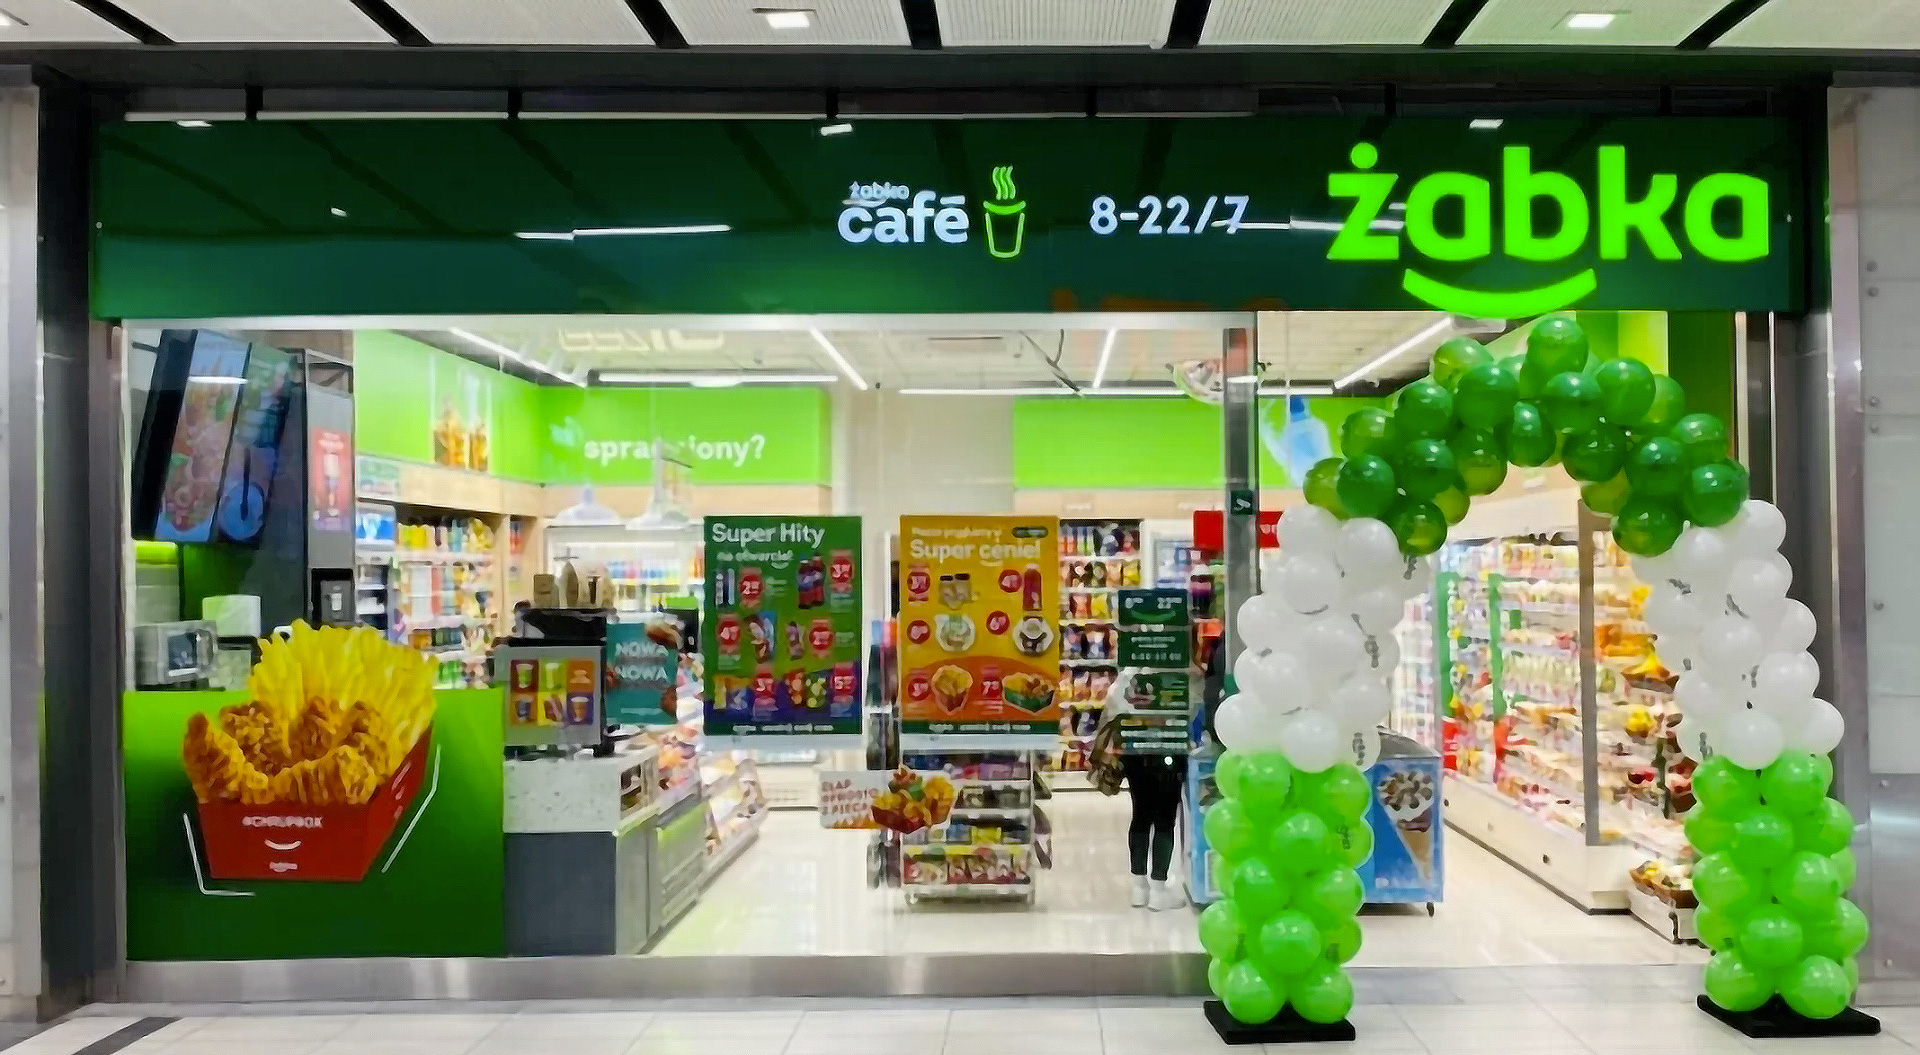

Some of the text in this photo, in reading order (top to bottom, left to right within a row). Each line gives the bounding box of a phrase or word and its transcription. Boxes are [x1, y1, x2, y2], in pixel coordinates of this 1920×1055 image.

[1089, 195, 1250, 235] 8-22/7
[1327, 142, 1769, 262] żabka
[711, 522, 826, 549] Super Hity
